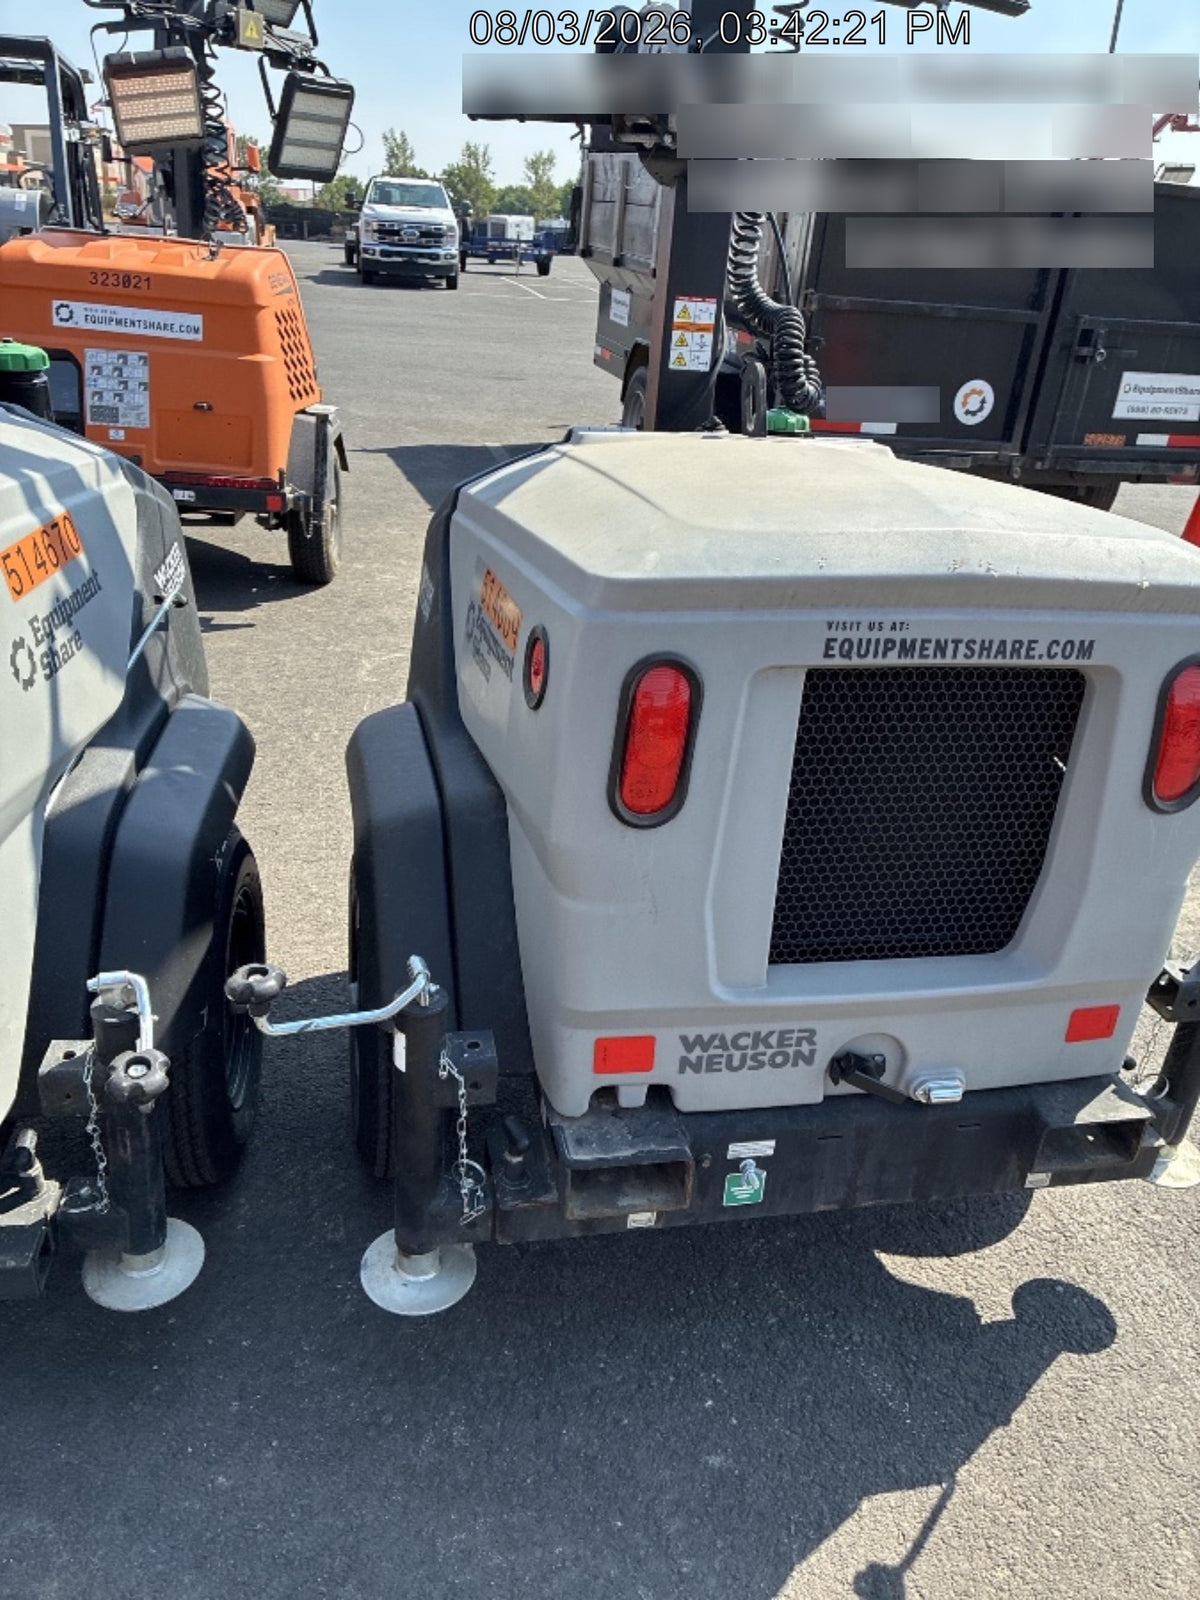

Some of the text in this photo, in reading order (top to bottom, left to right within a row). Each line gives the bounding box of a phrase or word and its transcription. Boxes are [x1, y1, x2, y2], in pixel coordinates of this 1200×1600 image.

[89, 271, 151, 290] 323021
[84, 314, 200, 335] EQUIPMENTSHARE.COM
[1, 515, 81, 596] 514670
[28, 568, 103, 648] Equipment
[826, 621, 910, 632] VISIT US AT:
[823, 637, 1096, 660] EQUIPMENTSHARE.COM
[679, 1028, 817, 1054] WACKER
[678, 1048, 817, 1074] NEUSON
